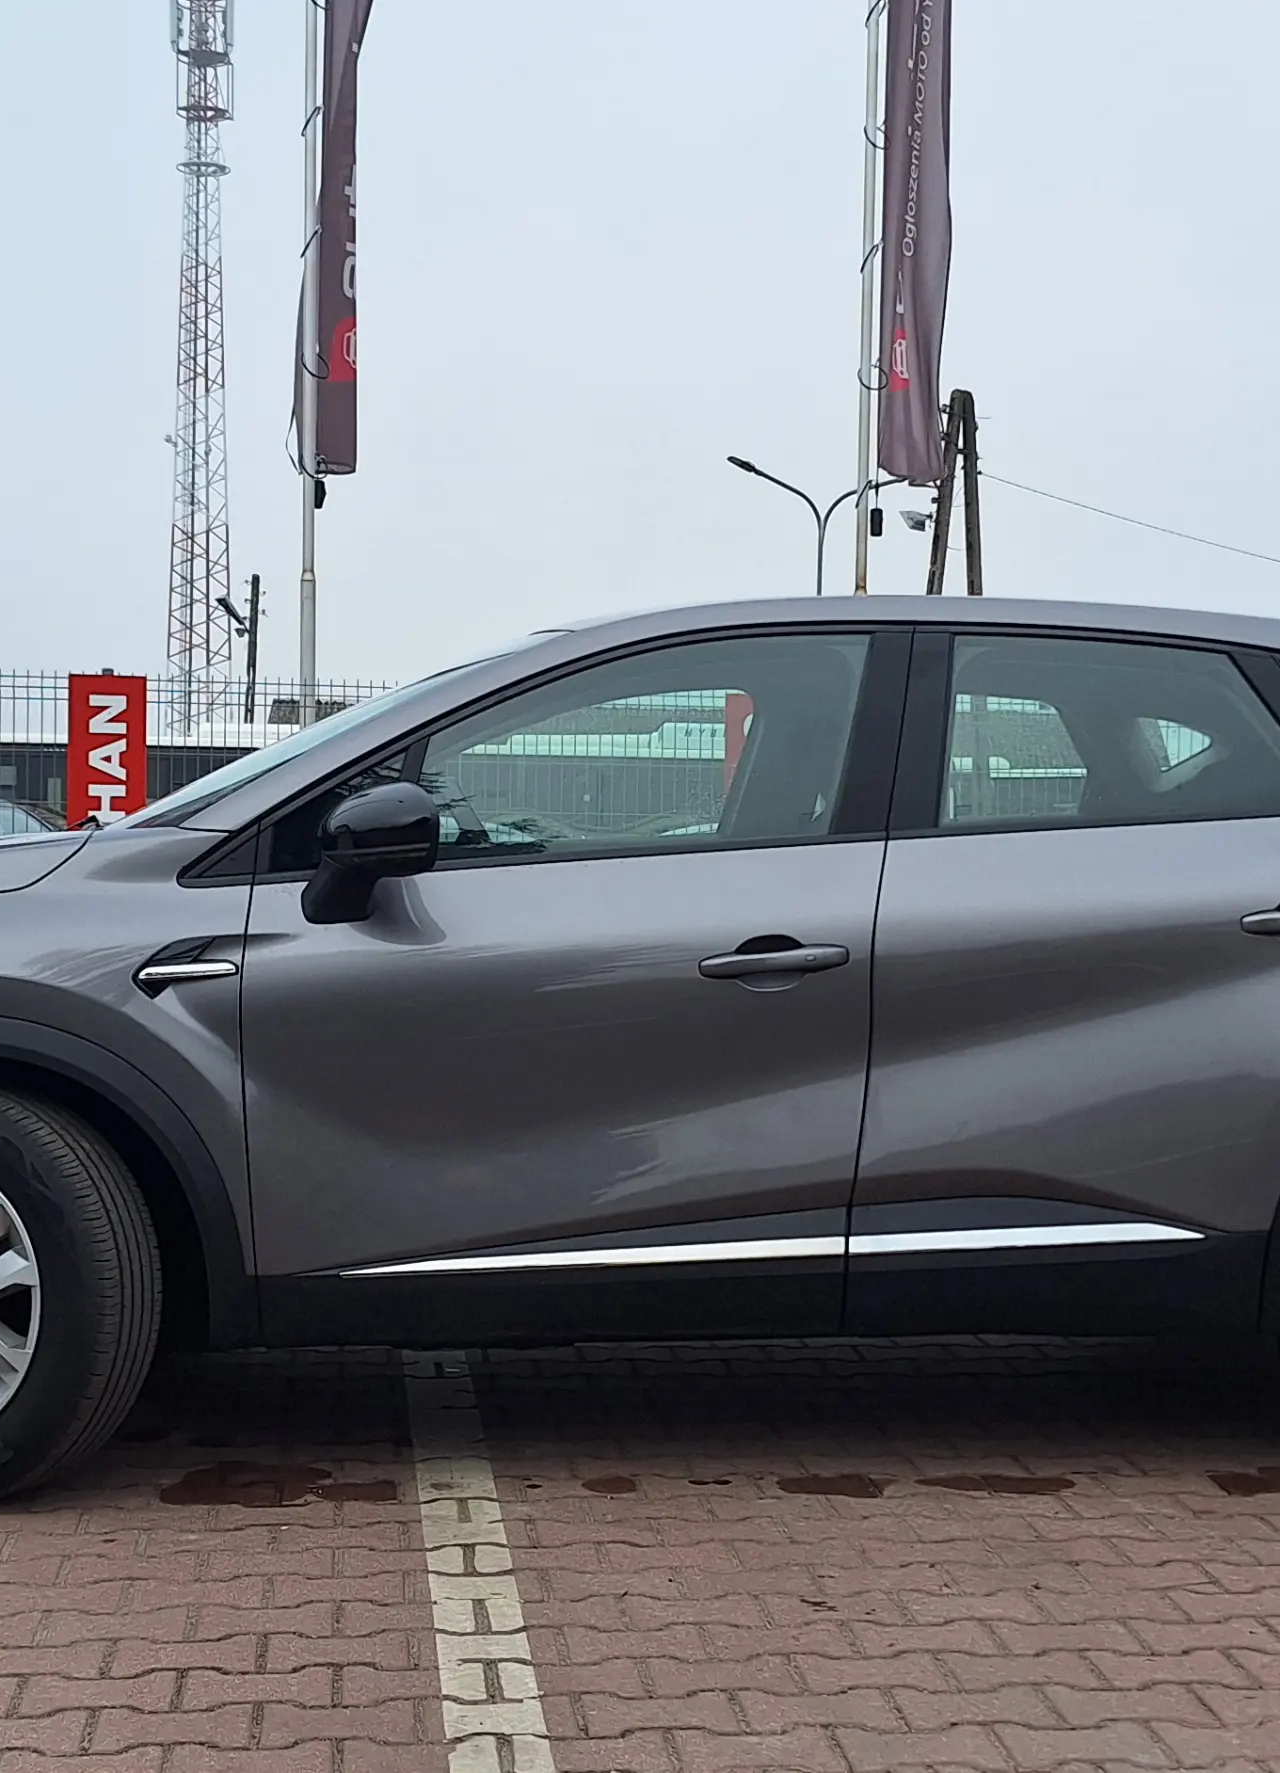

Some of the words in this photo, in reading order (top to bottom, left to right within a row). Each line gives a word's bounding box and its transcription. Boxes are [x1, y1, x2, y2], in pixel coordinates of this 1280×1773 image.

[902, 130, 922, 257] Ogłoszenia
[913, 50, 929, 125] MOTO
[87, 694, 127, 824] HAN
